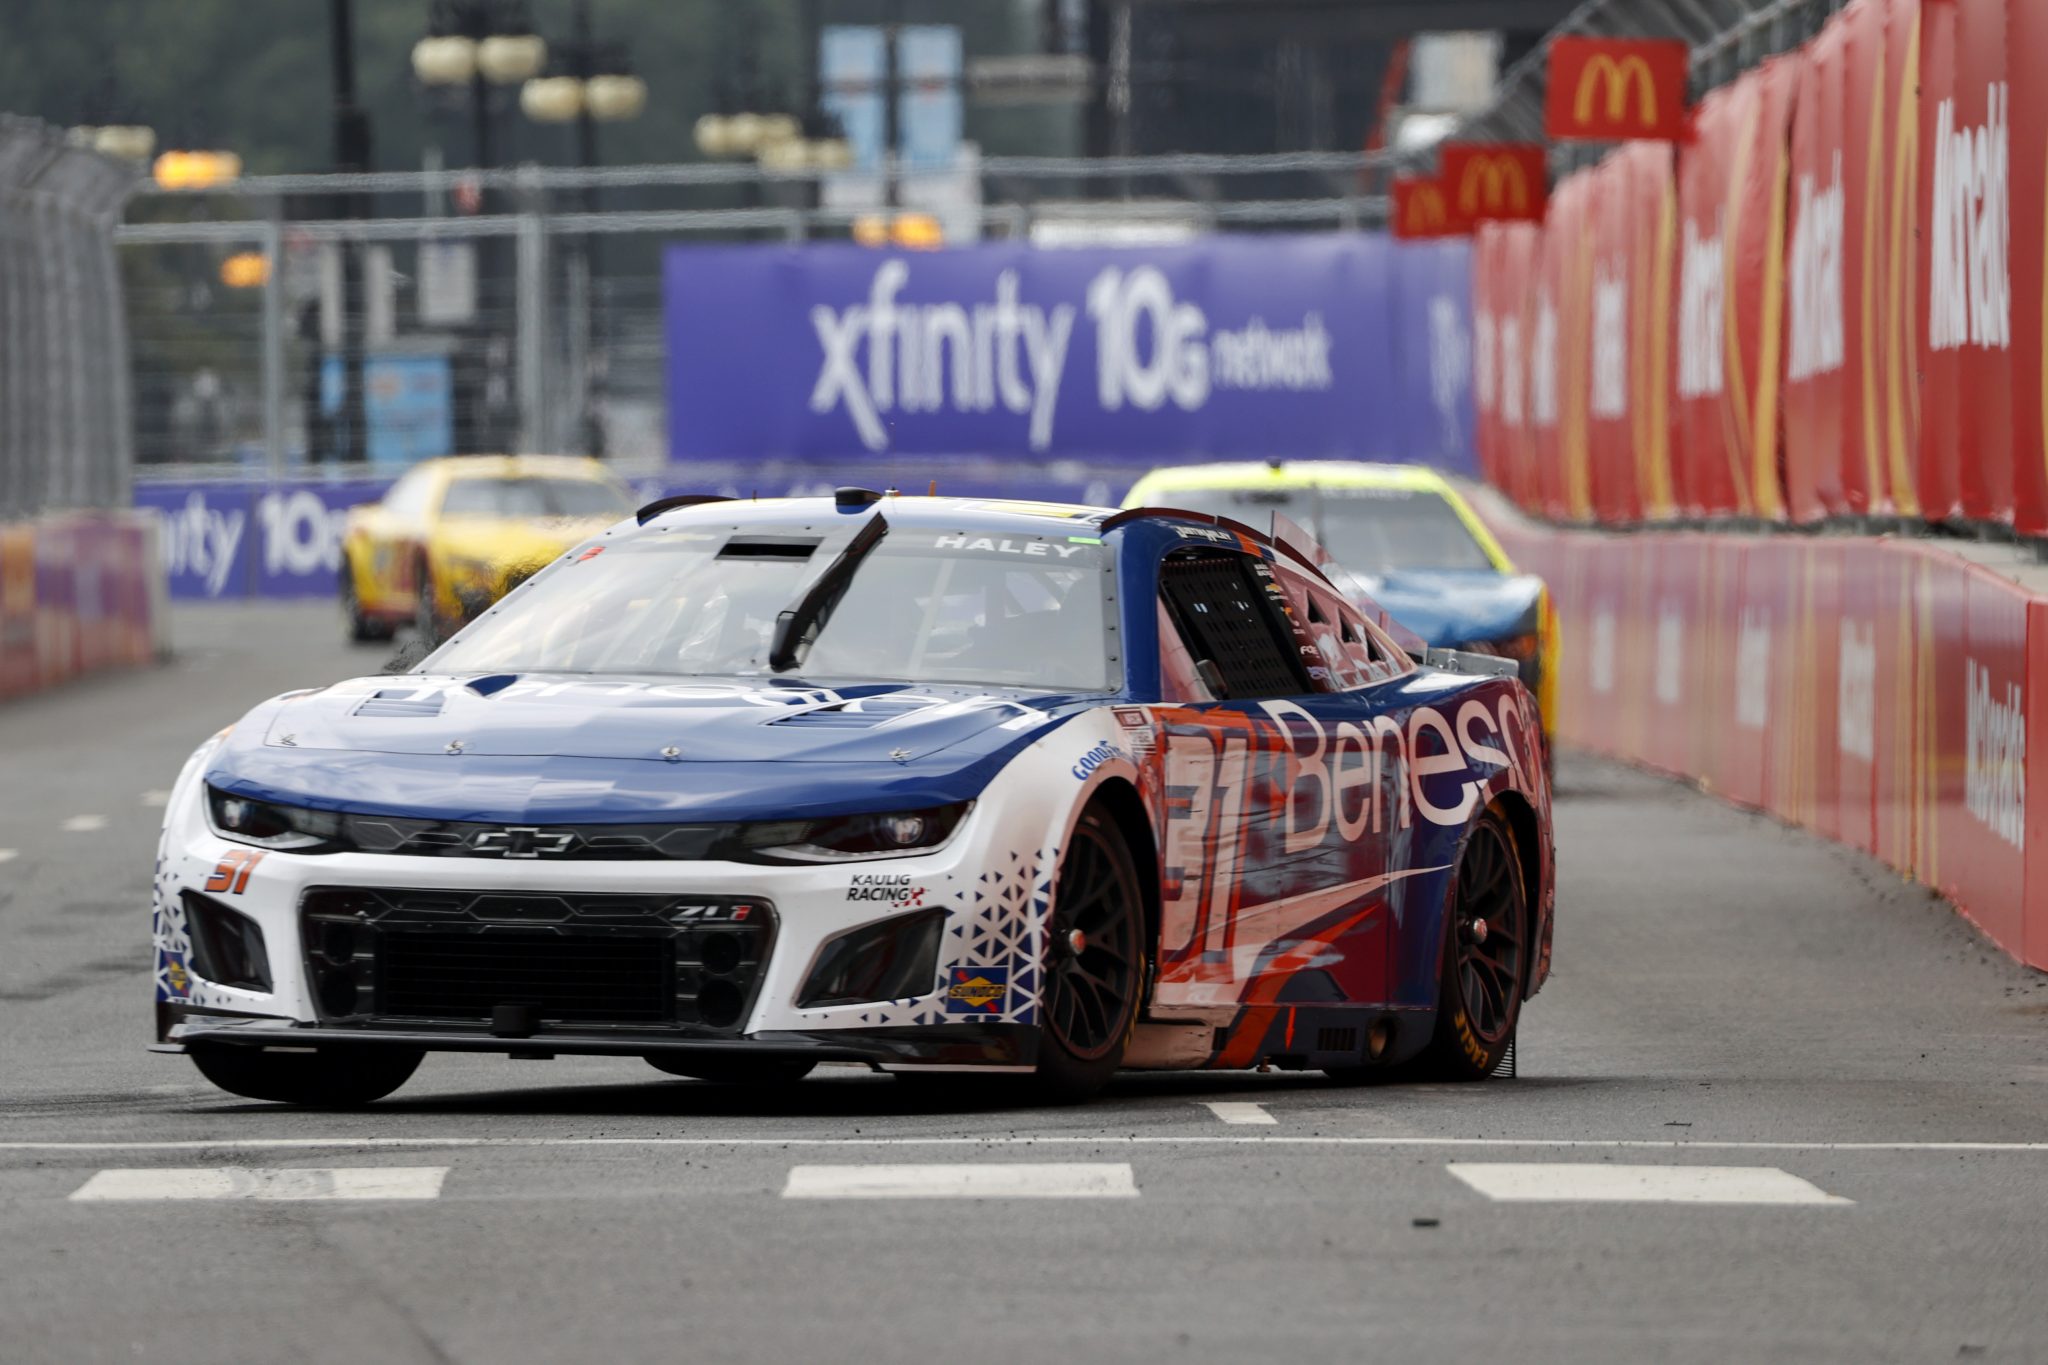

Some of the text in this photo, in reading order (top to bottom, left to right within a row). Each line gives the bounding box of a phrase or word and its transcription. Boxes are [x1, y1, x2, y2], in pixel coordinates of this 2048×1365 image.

[811, 257, 1077, 453] xfinity
[1086, 263, 1211, 414] 10G
[934, 535, 1082, 559] HALEY
[1258, 692, 1539, 854] Benesc
[1161, 734, 1248, 951] 31
[203, 849, 269, 895] 31
[846, 887, 909, 901] RACING
[850, 873, 912, 886] KAULIG
